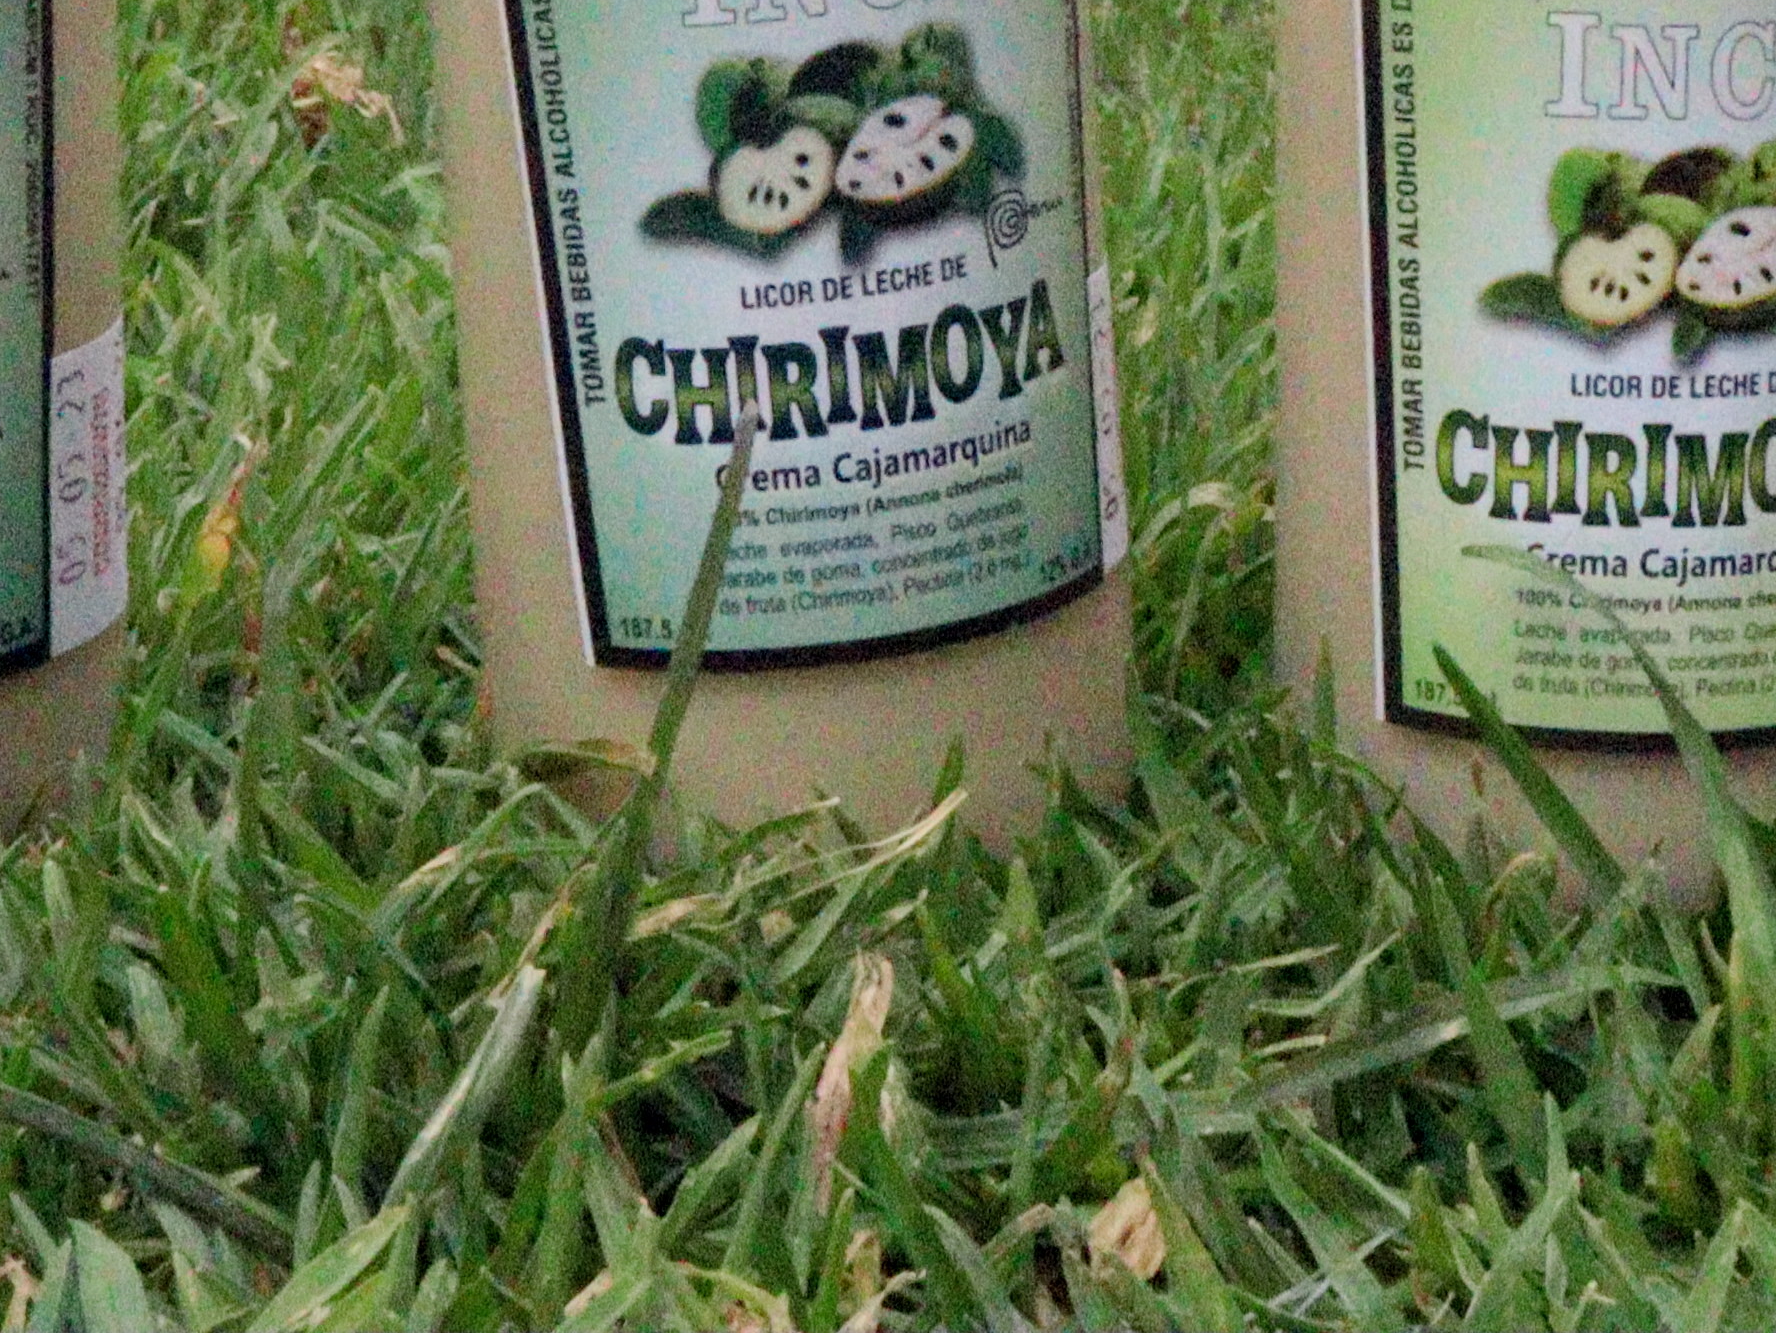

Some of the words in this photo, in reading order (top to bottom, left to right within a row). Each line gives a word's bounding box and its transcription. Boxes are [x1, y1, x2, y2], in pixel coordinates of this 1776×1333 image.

[1391, 20, 1414, 55] ES
[557, 188, 593, 303] BEBIDAS
[740, 281, 812, 311] LICOR
[822, 275, 853, 303] DE
[861, 265, 933, 295] LECHE
[940, 254, 968, 282] DE
[574, 312, 606, 408] TOMAR
[1398, 258, 1423, 370] BEBIDAS
[614, 277, 1065, 446] CHIRIMOYA
[1570, 373, 1641, 399] LICOR
[1651, 375, 1681, 399] DE
[1690, 370, 1759, 399] LECHE
[715, 460, 821, 494] Cema
[832, 417, 1032, 489] Cajamarquina
[1401, 379, 1425, 473] TOMAR
